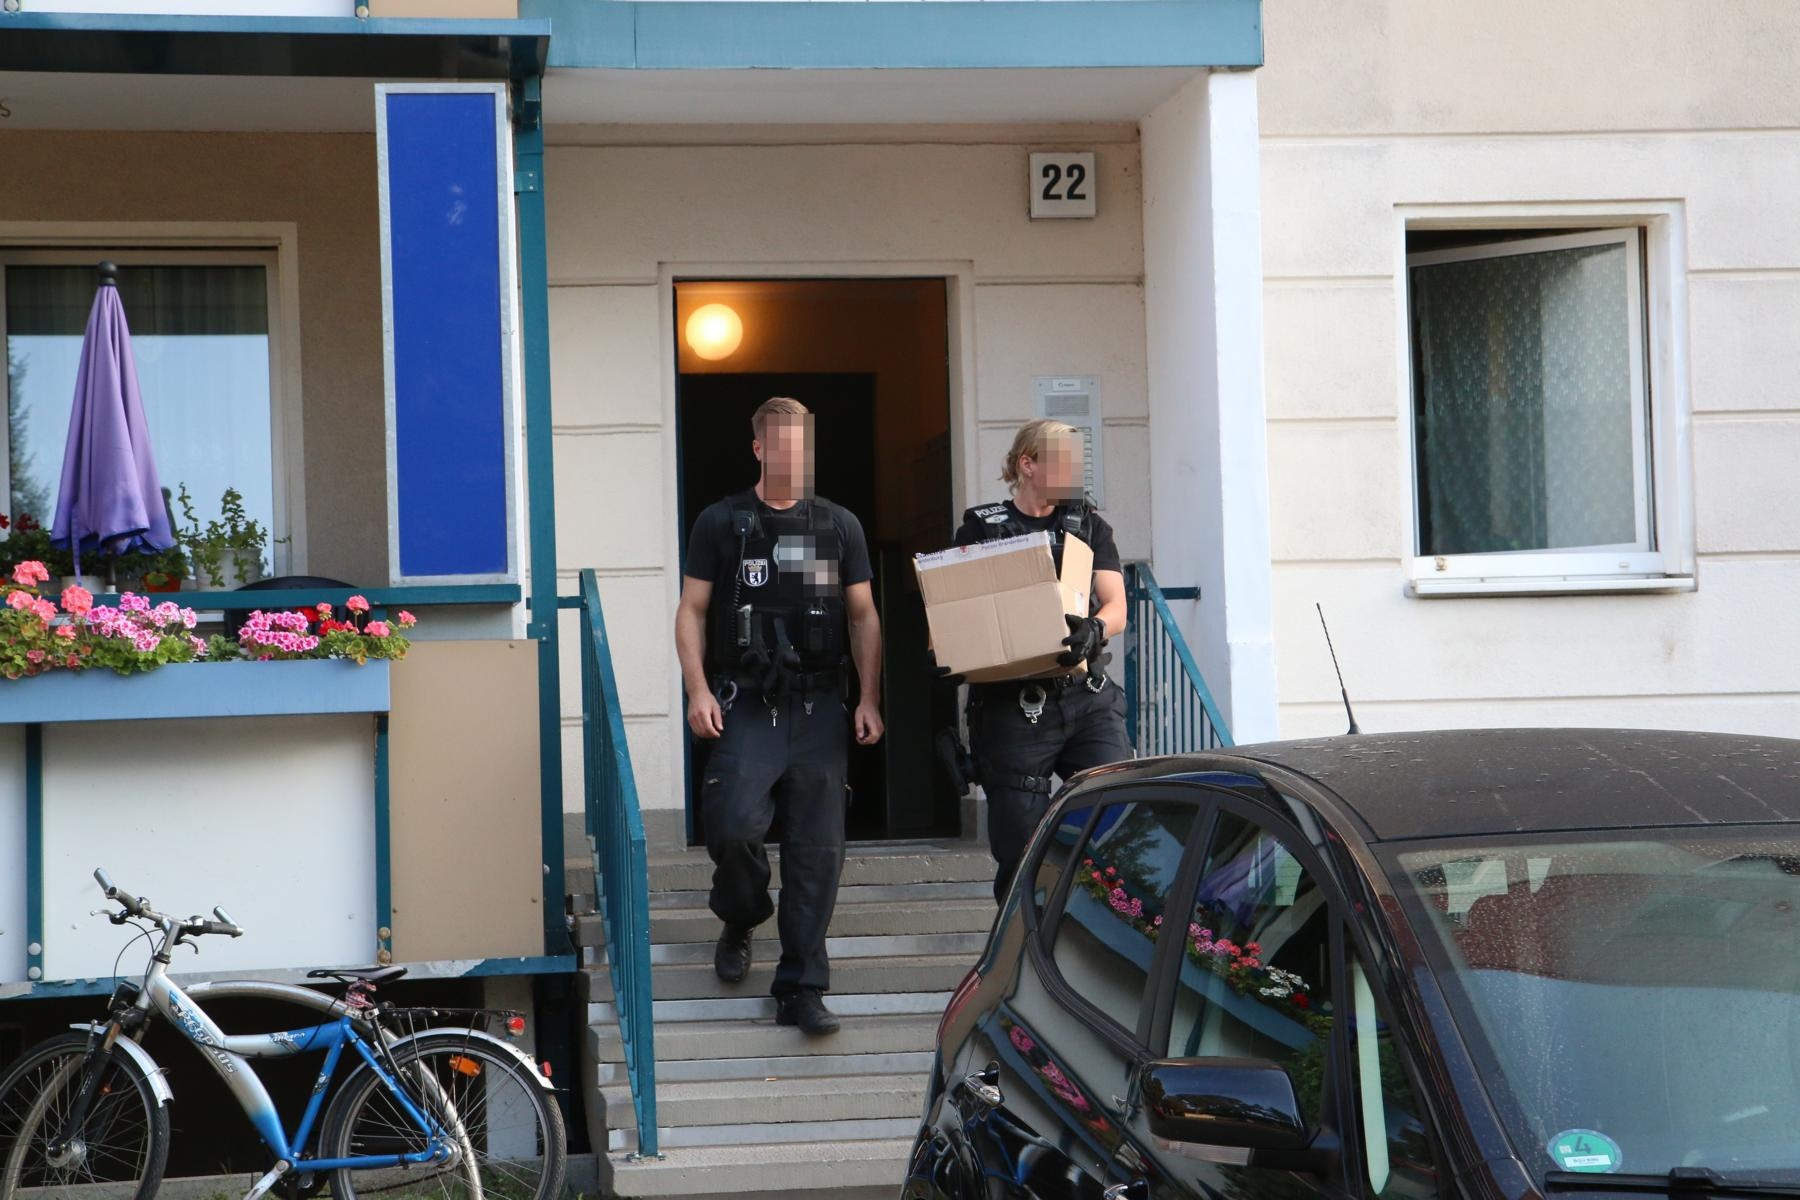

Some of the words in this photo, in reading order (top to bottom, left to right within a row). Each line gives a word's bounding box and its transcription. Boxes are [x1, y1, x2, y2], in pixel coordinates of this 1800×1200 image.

[1042, 163, 1086, 200] 22
[975, 505, 1008, 518] POLIZEI
[1575, 1136, 1592, 1153] 4
